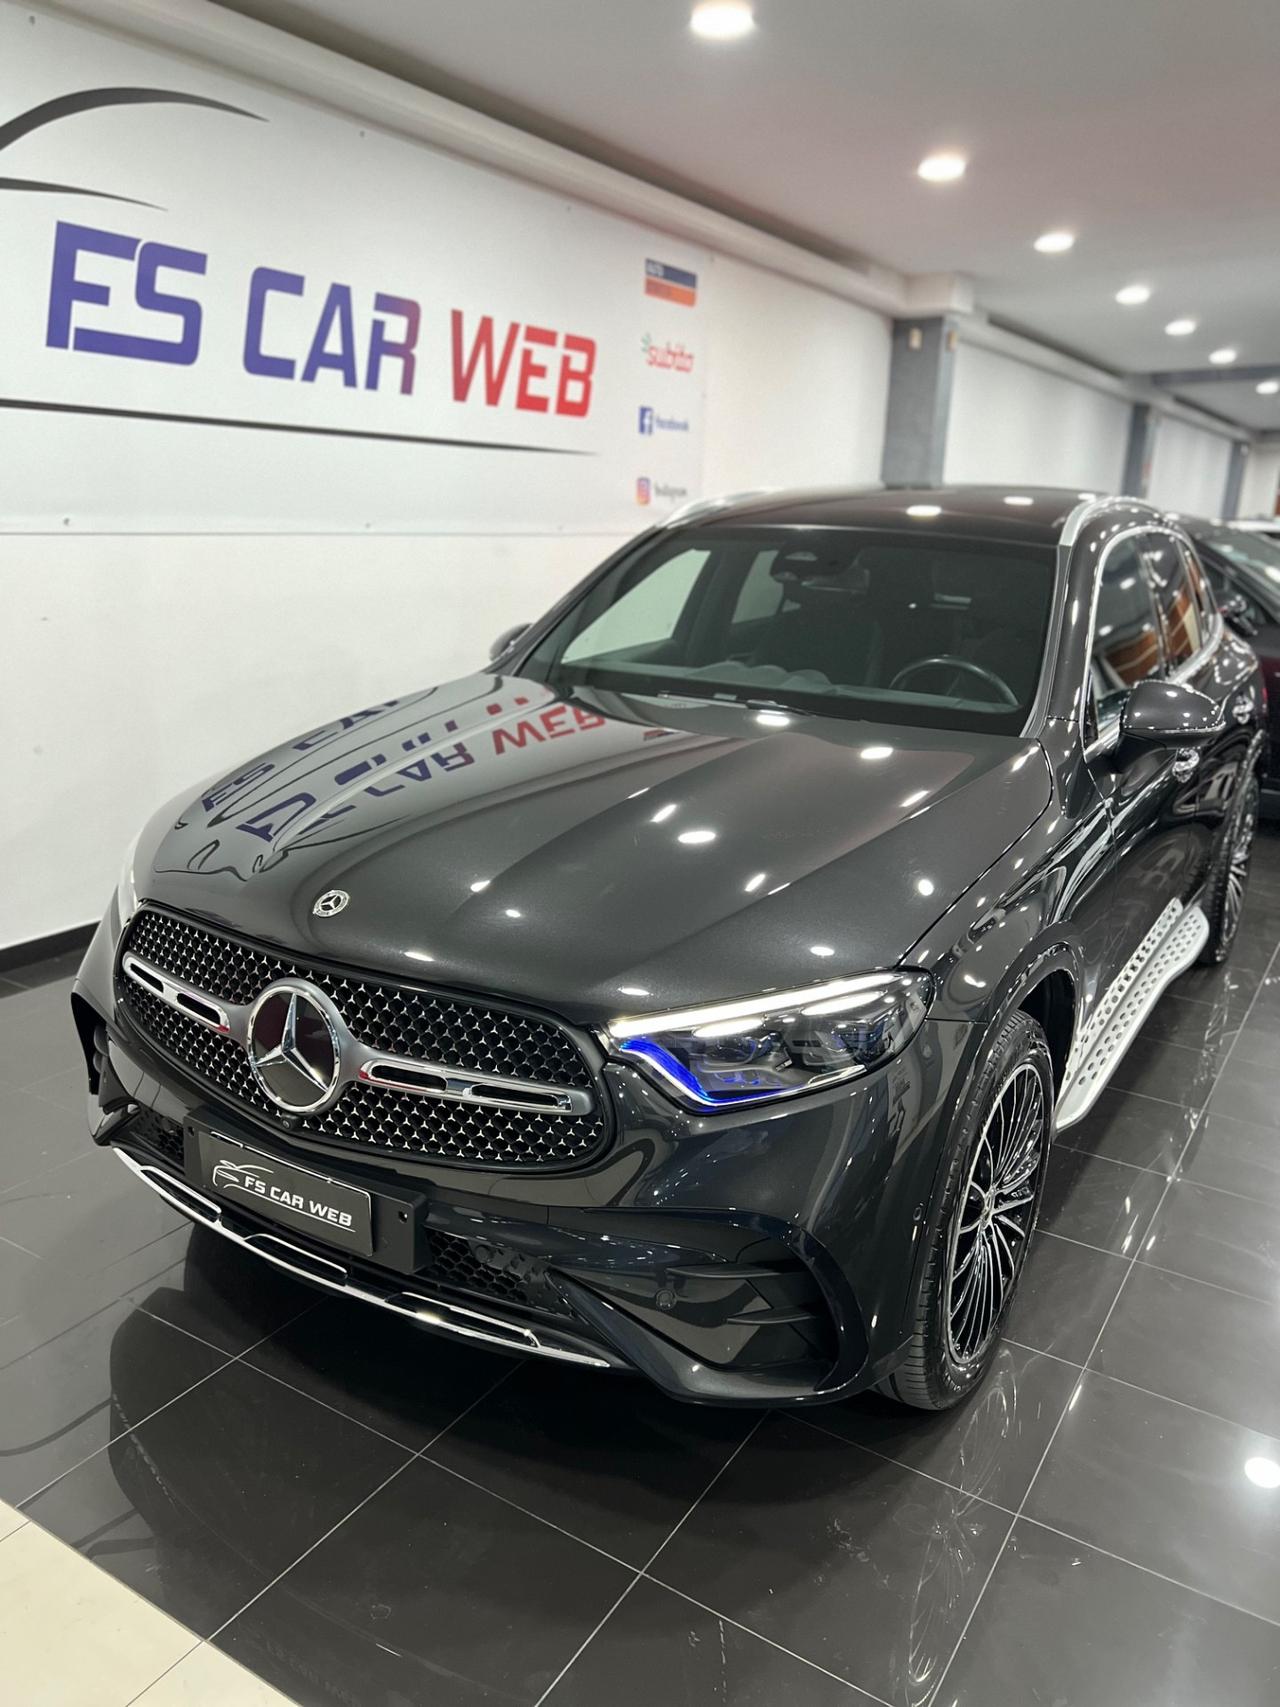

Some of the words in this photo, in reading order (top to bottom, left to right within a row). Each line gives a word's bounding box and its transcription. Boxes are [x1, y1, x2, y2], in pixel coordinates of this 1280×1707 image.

[243, 266, 421, 396] CAR
[450, 308, 597, 418] WEB
[244, 1175, 266, 1194] FS
[270, 1186, 304, 1209] CAR
[309, 1200, 352, 1227] WEB
